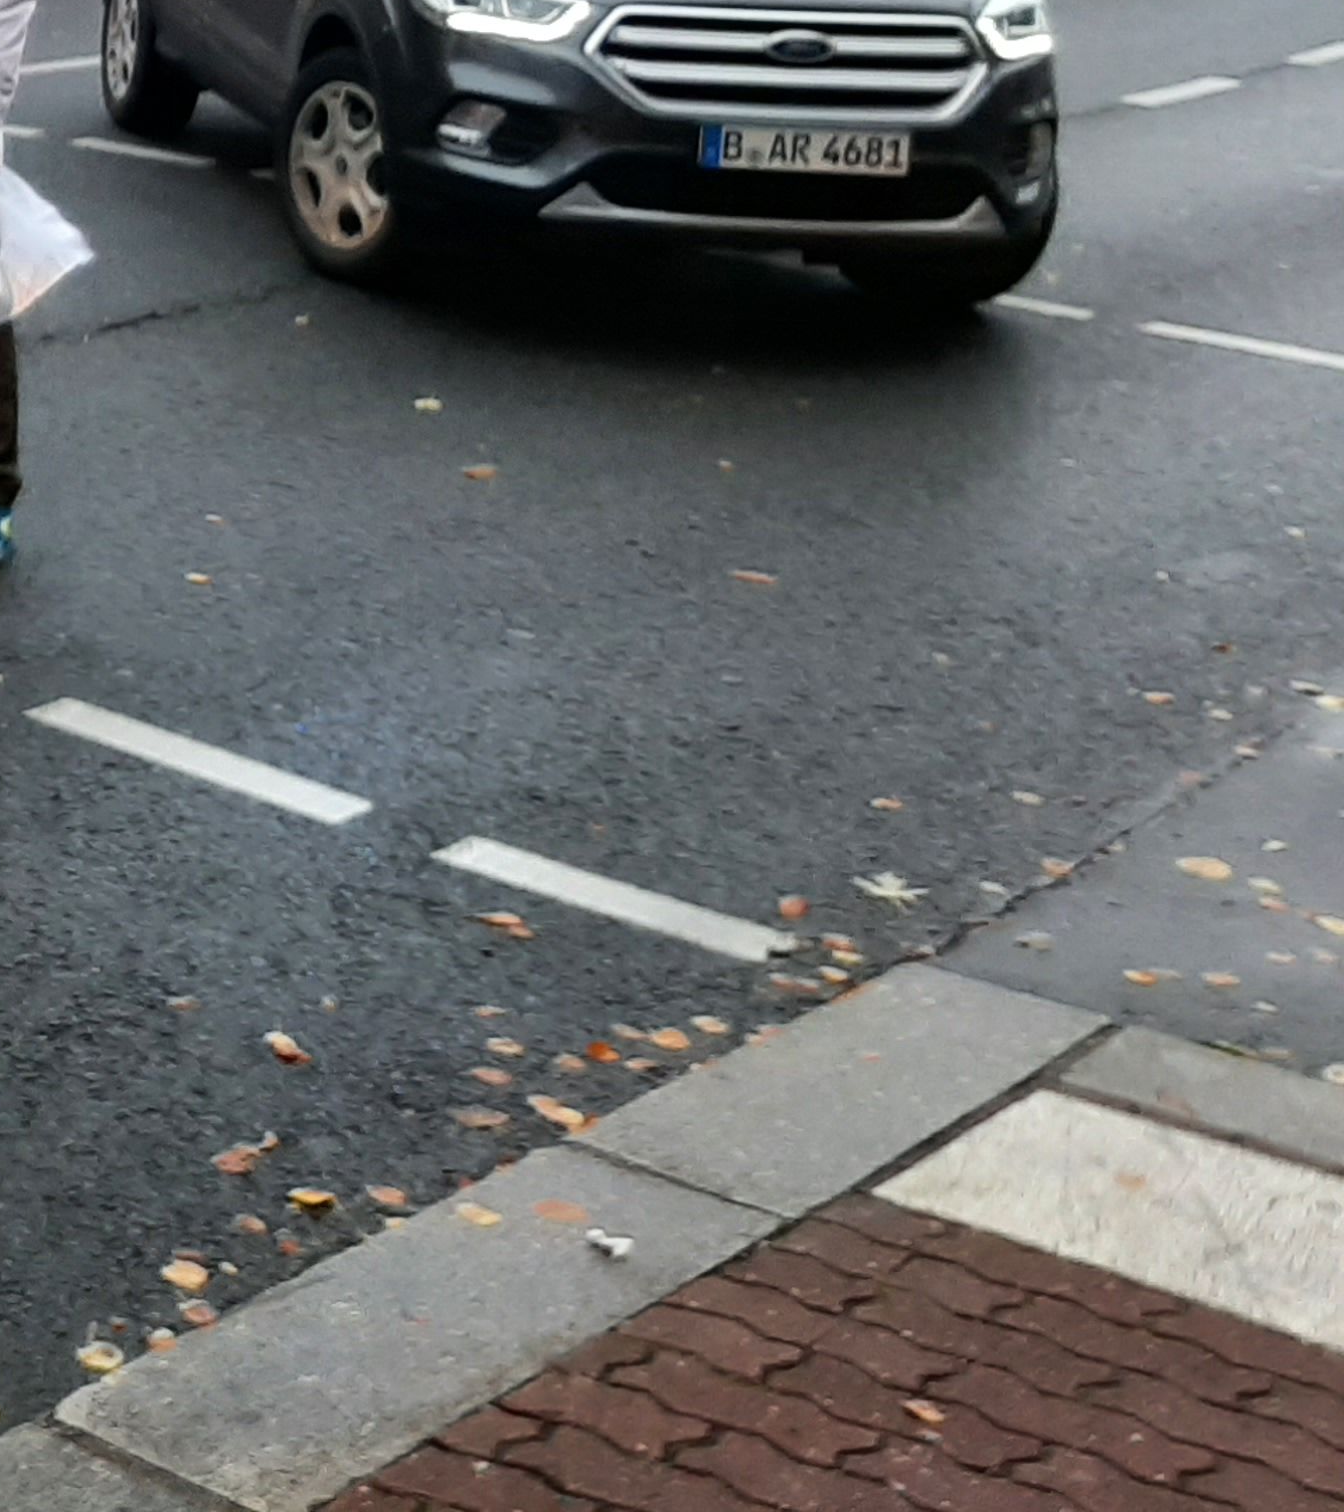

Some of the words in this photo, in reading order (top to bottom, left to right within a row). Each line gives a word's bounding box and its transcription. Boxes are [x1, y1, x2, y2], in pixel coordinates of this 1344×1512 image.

[722, 131, 743, 161] B
[768, 132, 811, 164] AR
[821, 135, 904, 169] 4681
